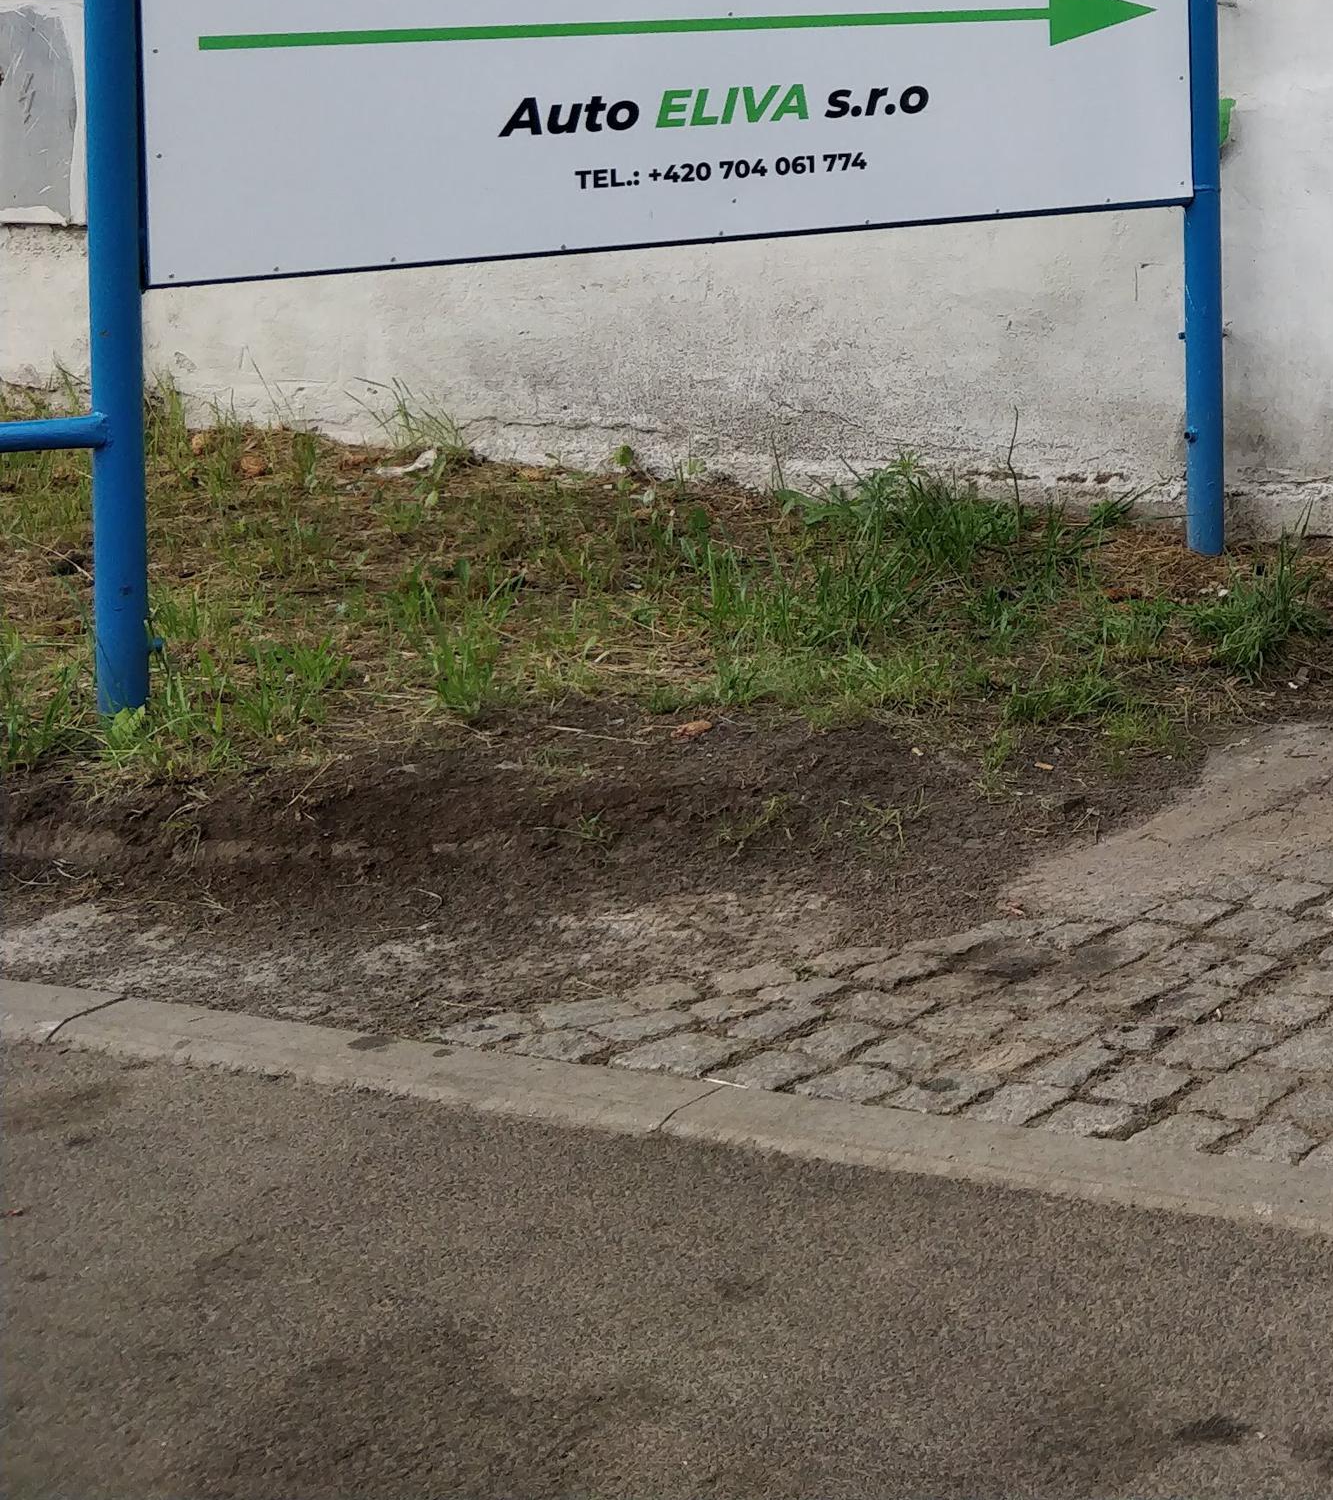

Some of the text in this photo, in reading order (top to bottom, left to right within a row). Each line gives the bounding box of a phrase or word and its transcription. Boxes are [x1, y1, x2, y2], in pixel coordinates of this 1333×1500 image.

[497, 83, 930, 138] Auto ELIVA s.r.o
[574, 151, 868, 190] TEL.: +420 704 061 774
